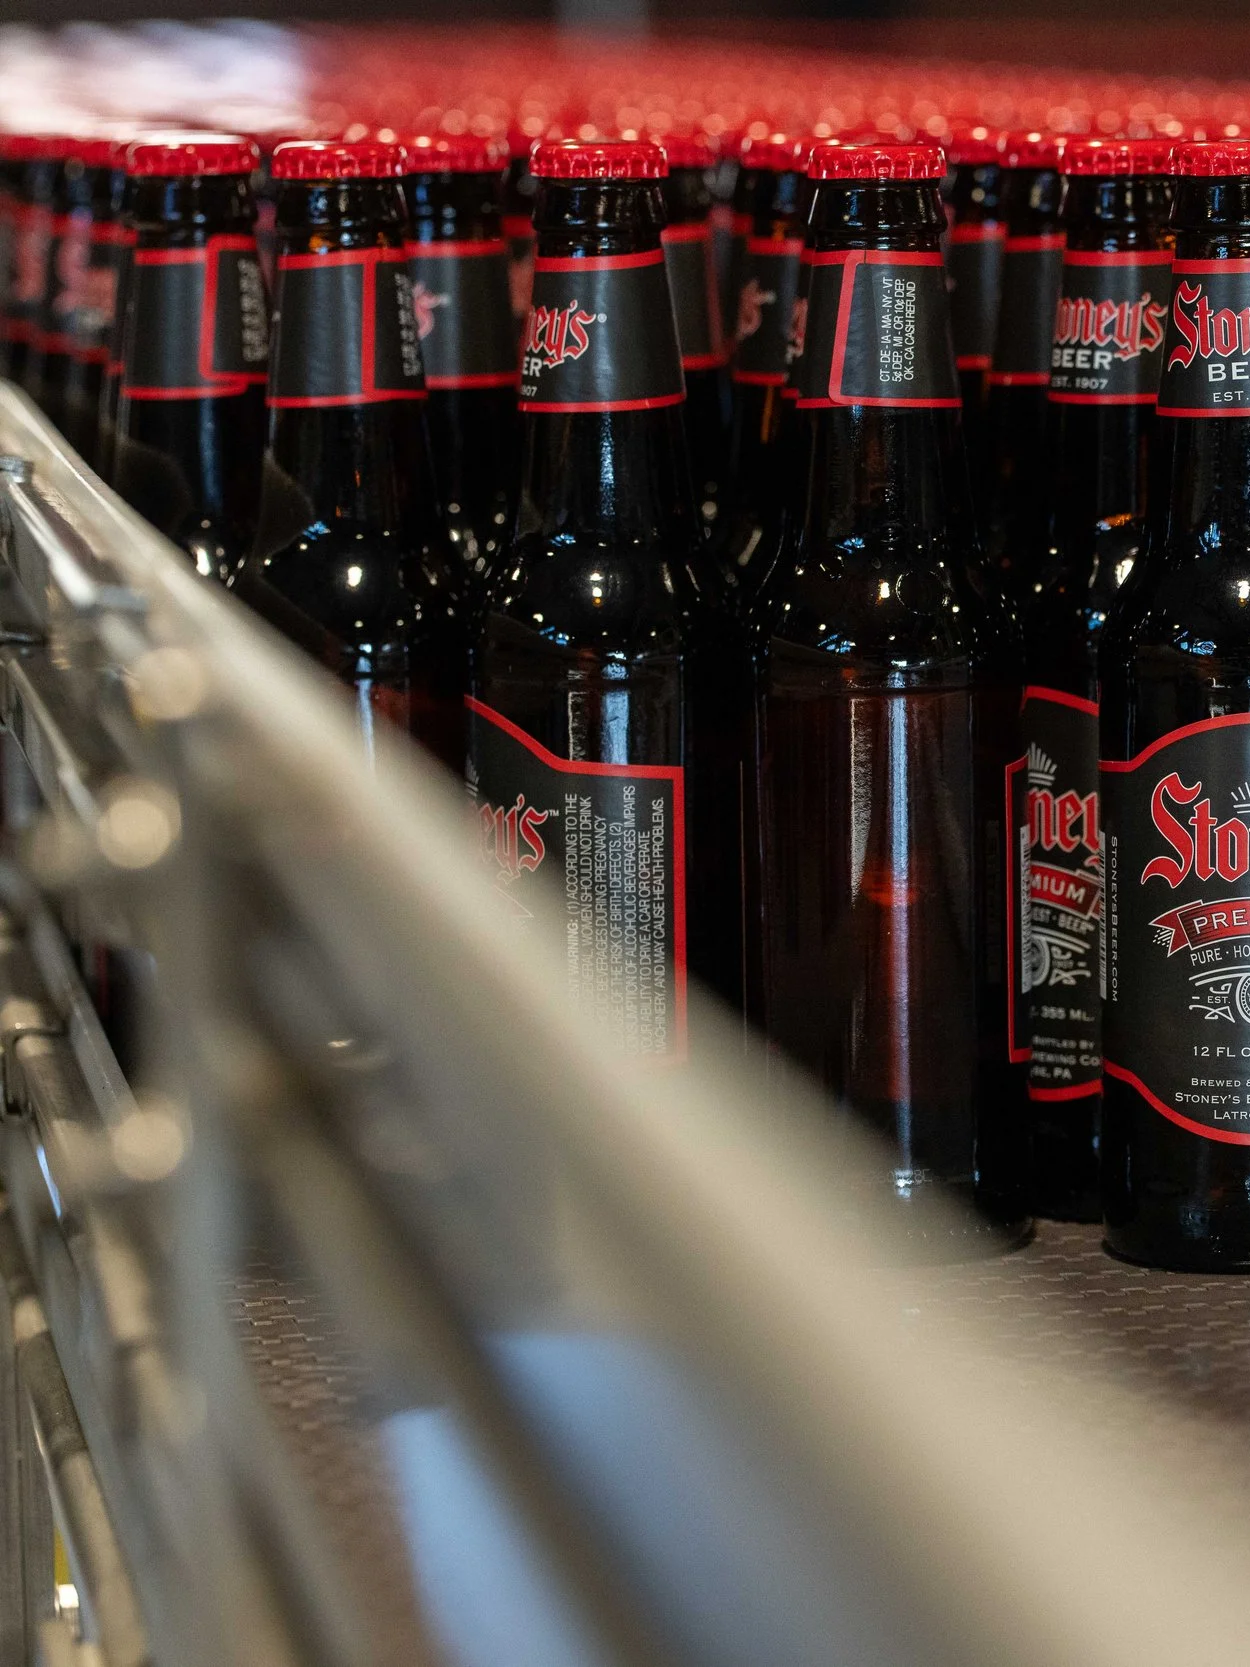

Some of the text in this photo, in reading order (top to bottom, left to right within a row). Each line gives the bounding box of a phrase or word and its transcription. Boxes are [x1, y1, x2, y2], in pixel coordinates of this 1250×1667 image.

[880, 277, 893, 382] CT DE IA MA NY VT
[893, 316, 903, 330] OR
[904, 281, 916, 380] OK CA CASH REFUND
[893, 336, 903, 347] MI
[1213, 391, 1249, 402] EST.
[565, 793, 577, 815] THE
[580, 796, 592, 830] DRINK
[565, 816, 577, 832] TO
[580, 831, 592, 855] NOT
[638, 831, 650, 879] OPERATE
[566, 834, 578, 900] ACCORDING
[580, 857, 592, 902] SHOULD
[594, 816, 607, 926] DURING PREGNANCY
[623, 785, 636, 957] ALCOHOLIC BEVERAGES IMPAIRS
[652, 860, 665, 900] HEALTH
[638, 881, 650, 898] OR
[610, 890, 622, 921] BIRTH
[638, 899, 650, 922] CAR
[652, 902, 665, 939] CAUSE
[1190, 948, 1222, 966] PURE
[1207, 995, 1231, 1004] EST.
[1194, 1046, 1210, 1057] 12
[1216, 1046, 1236, 1058] FL
